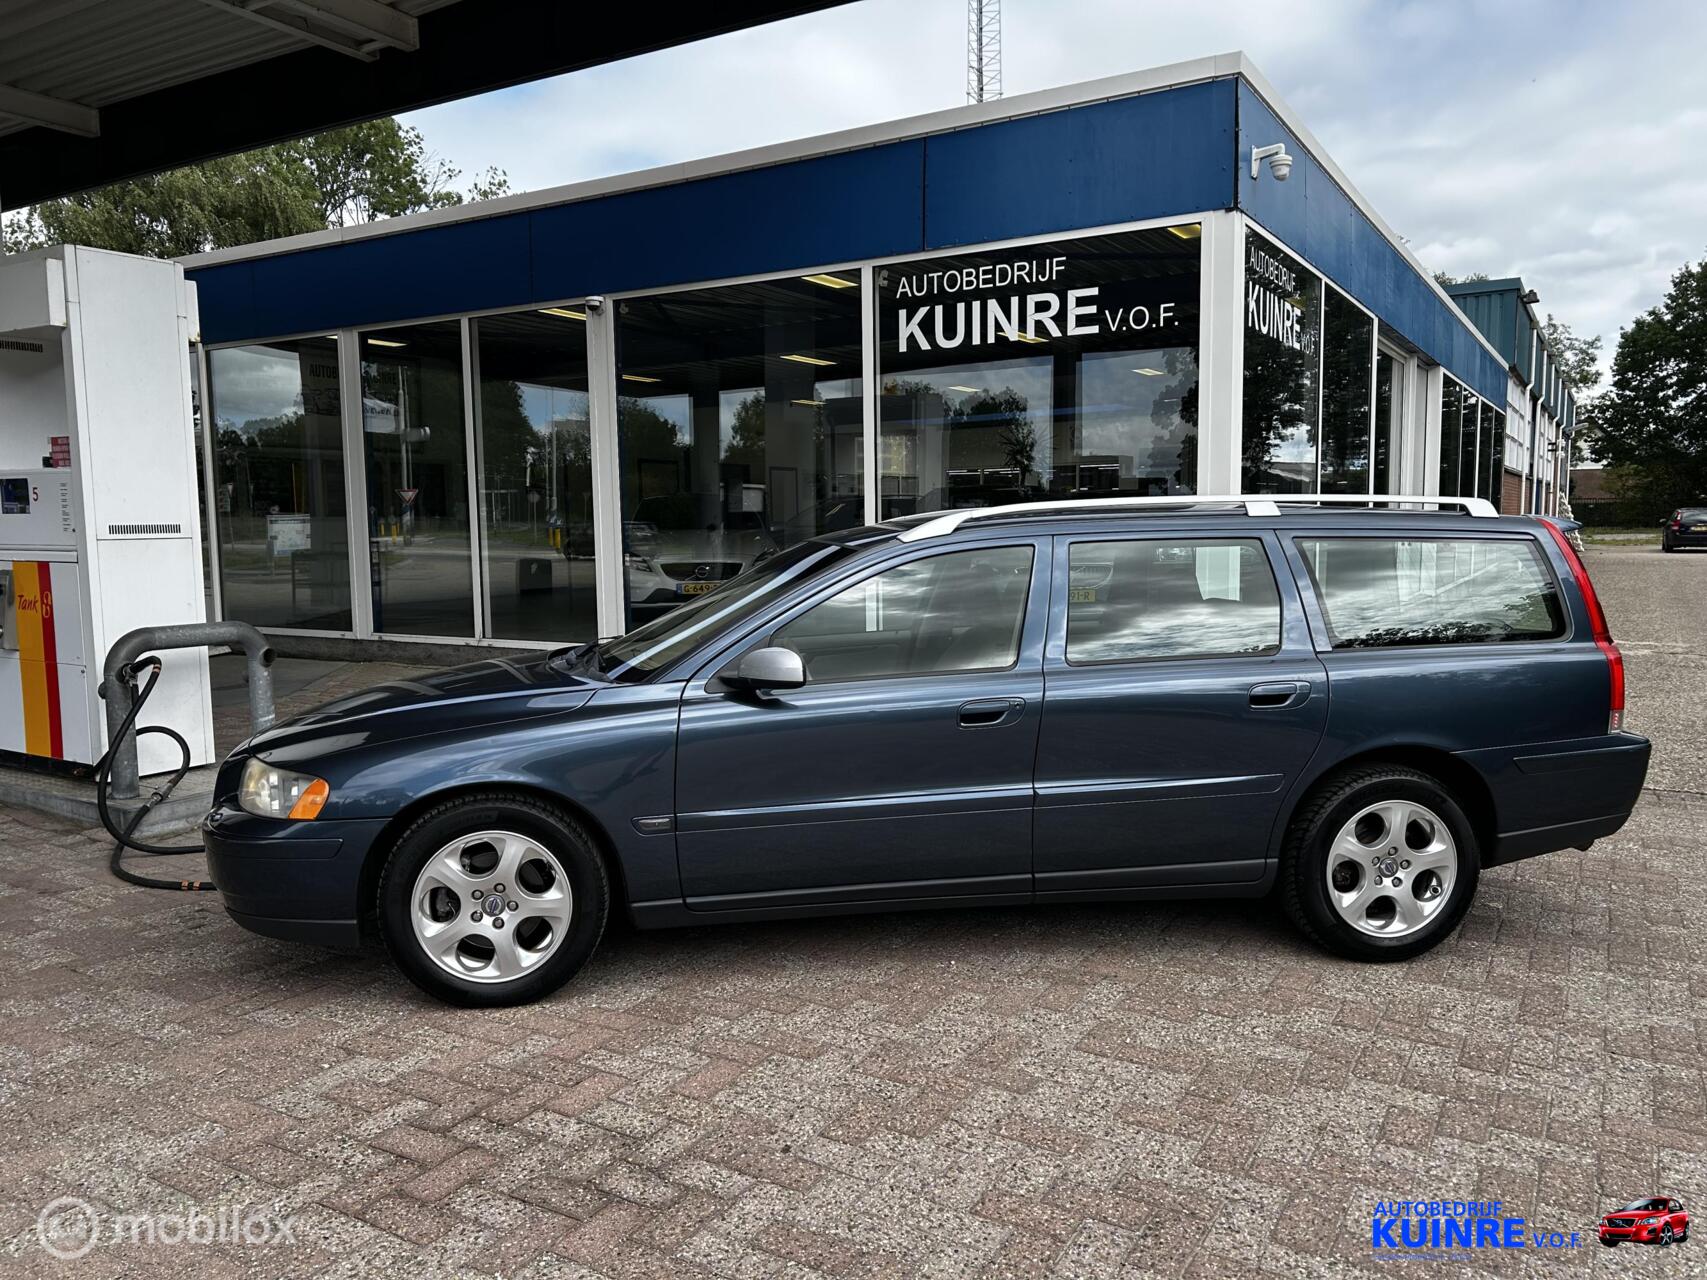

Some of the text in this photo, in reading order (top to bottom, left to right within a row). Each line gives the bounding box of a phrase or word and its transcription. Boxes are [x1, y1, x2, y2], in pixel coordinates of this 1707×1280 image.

[896, 256, 1067, 299] AUTOBEDRIJF
[1249, 246, 1297, 293] AUTOBEDRIJF
[898, 286, 1180, 353] KUINRE V.O.F.
[1248, 280, 1302, 351] KUINRE
[32, 486, 39, 502] 5
[18, 594, 38, 613] Tank
[683, 584, 719, 594] G-649-
